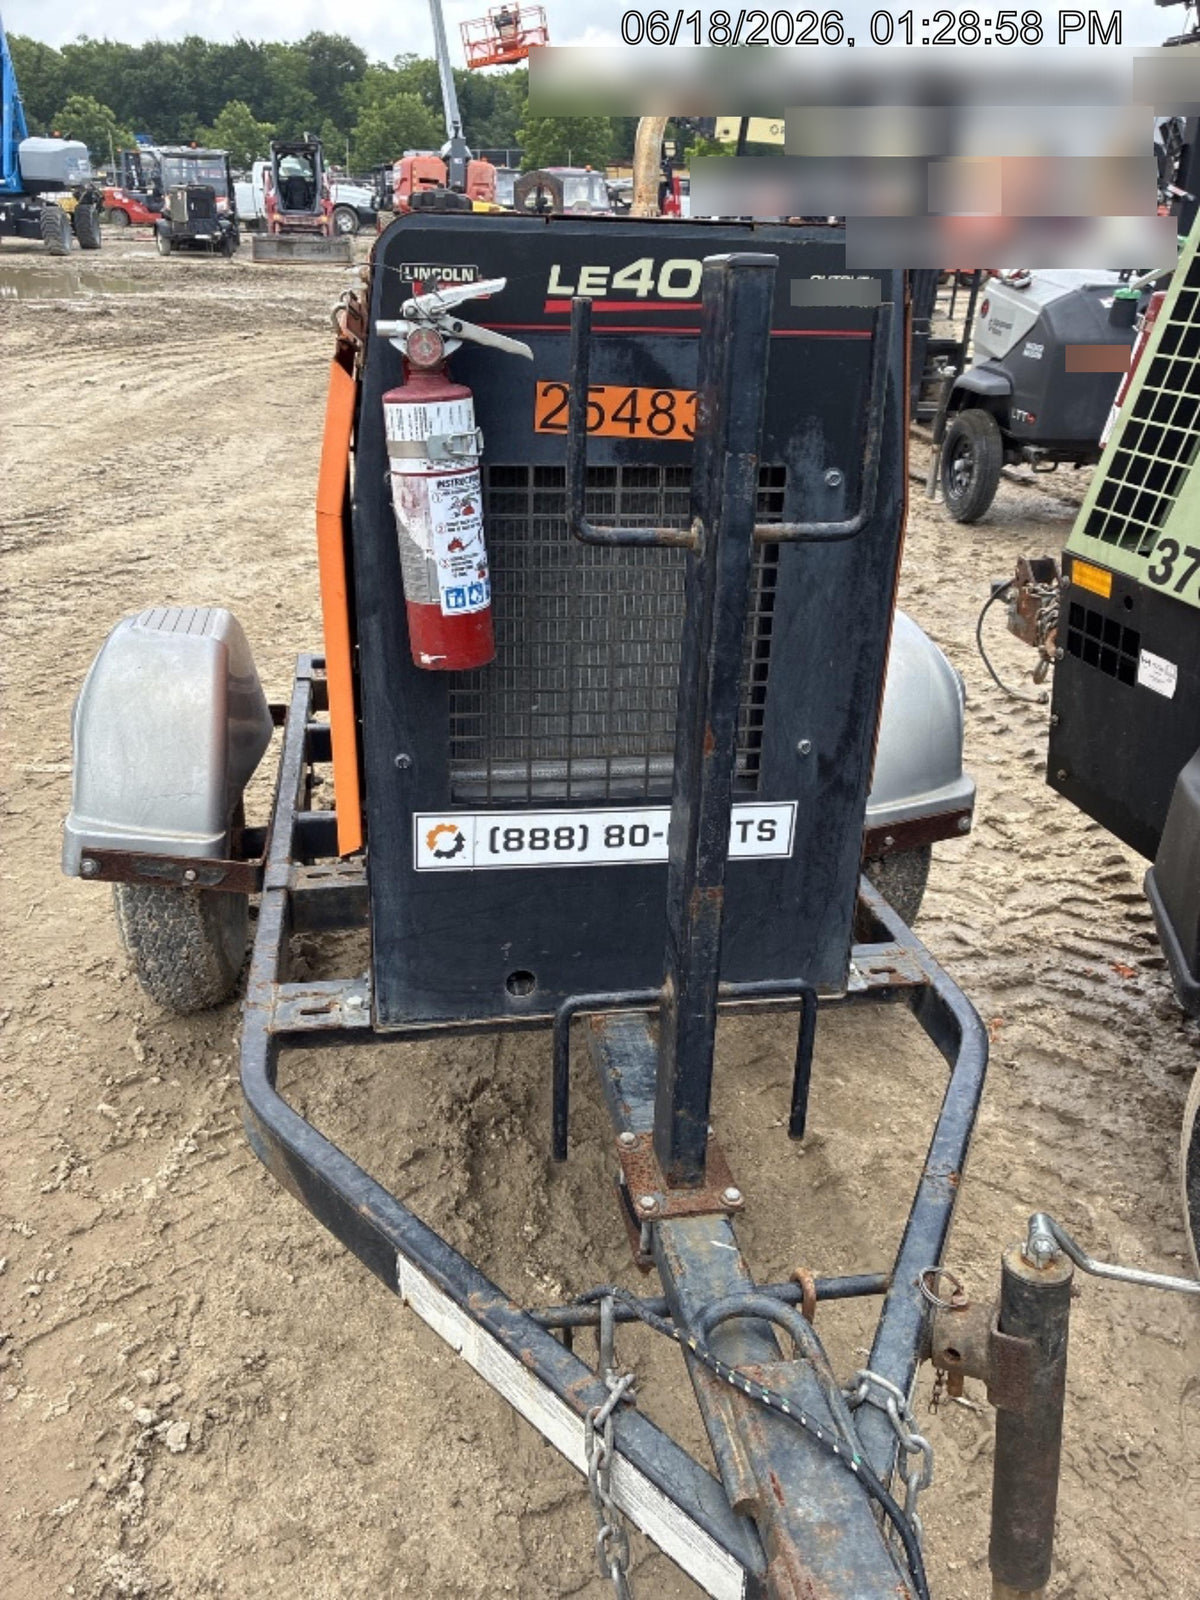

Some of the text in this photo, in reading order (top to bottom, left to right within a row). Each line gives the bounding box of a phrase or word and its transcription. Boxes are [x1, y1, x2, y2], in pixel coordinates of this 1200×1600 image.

[404, 266, 474, 282] LINCOLN
[1148, 538, 1200, 600] 37
[489, 819, 777, 854] (888) 80-TS
